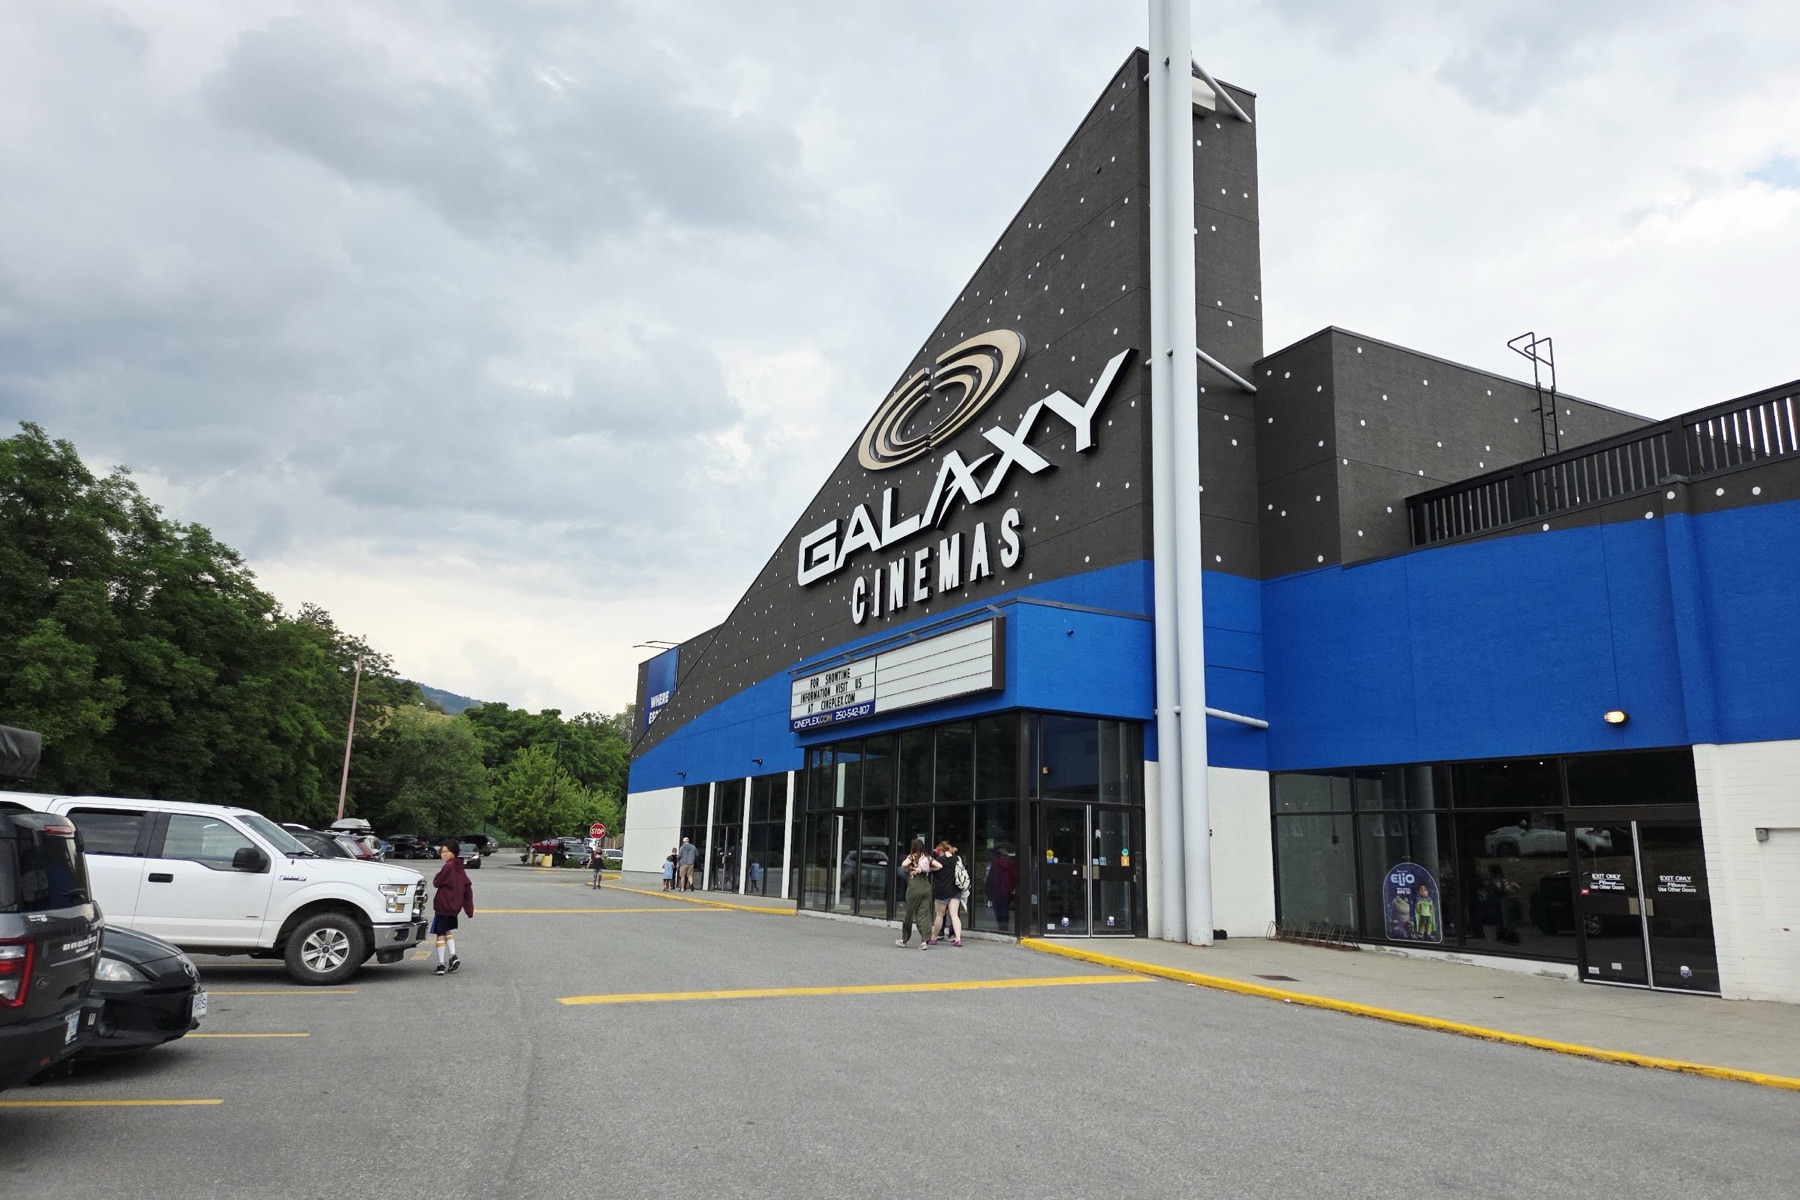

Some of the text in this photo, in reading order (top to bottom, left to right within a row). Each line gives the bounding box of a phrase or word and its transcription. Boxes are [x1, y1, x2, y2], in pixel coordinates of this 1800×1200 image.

[797, 347, 1137, 587] GALAXY
[851, 507, 1025, 625] CINEMAS
[810, 668, 850, 688] FOR SHOWTIME
[650, 690, 670, 709] WHERE
[800, 677, 862, 703] INFORMATION VISIT US
[808, 703, 814, 713] AT
[793, 713, 833, 729] CINEPLEX.COM
